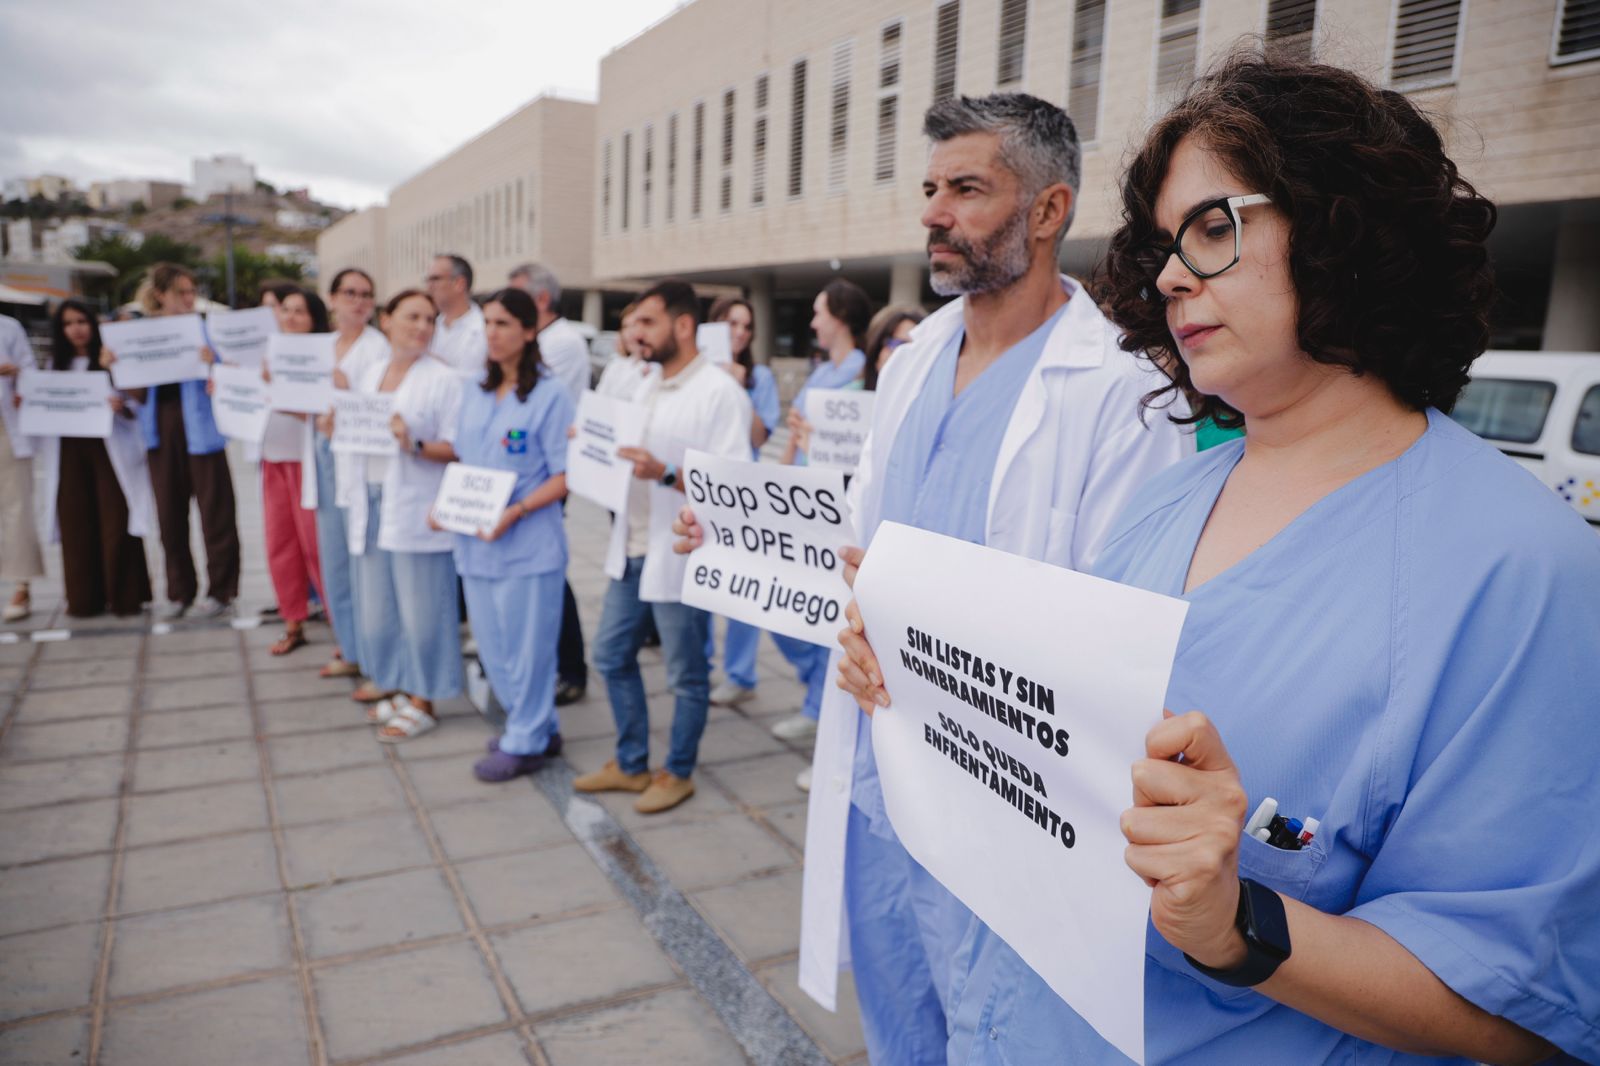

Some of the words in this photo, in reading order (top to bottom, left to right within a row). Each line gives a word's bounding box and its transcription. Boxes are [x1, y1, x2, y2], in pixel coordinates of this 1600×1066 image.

[825, 399, 861, 422] SCS
[461, 473, 494, 493] SCS
[689, 469, 758, 518] Stop
[764, 481, 841, 525] SCS
[710, 520, 734, 547] la
[741, 525, 795, 561] OPE
[804, 544, 836, 570] no
[694, 564, 722, 589] es
[729, 574, 760, 600] un
[762, 577, 839, 625] juego
[907, 626, 932, 657] SIN
[936, 639, 996, 687] LISTAS
[999, 667, 1013, 695] Y
[1016, 676, 1055, 715] SIN
[900, 648, 1070, 757] NOMBRAMIENTOS
[938, 712, 980, 751] SOLO
[982, 740, 1048, 798] QUEDA
[924, 723, 1076, 849] ENFRENTAMIENTO
